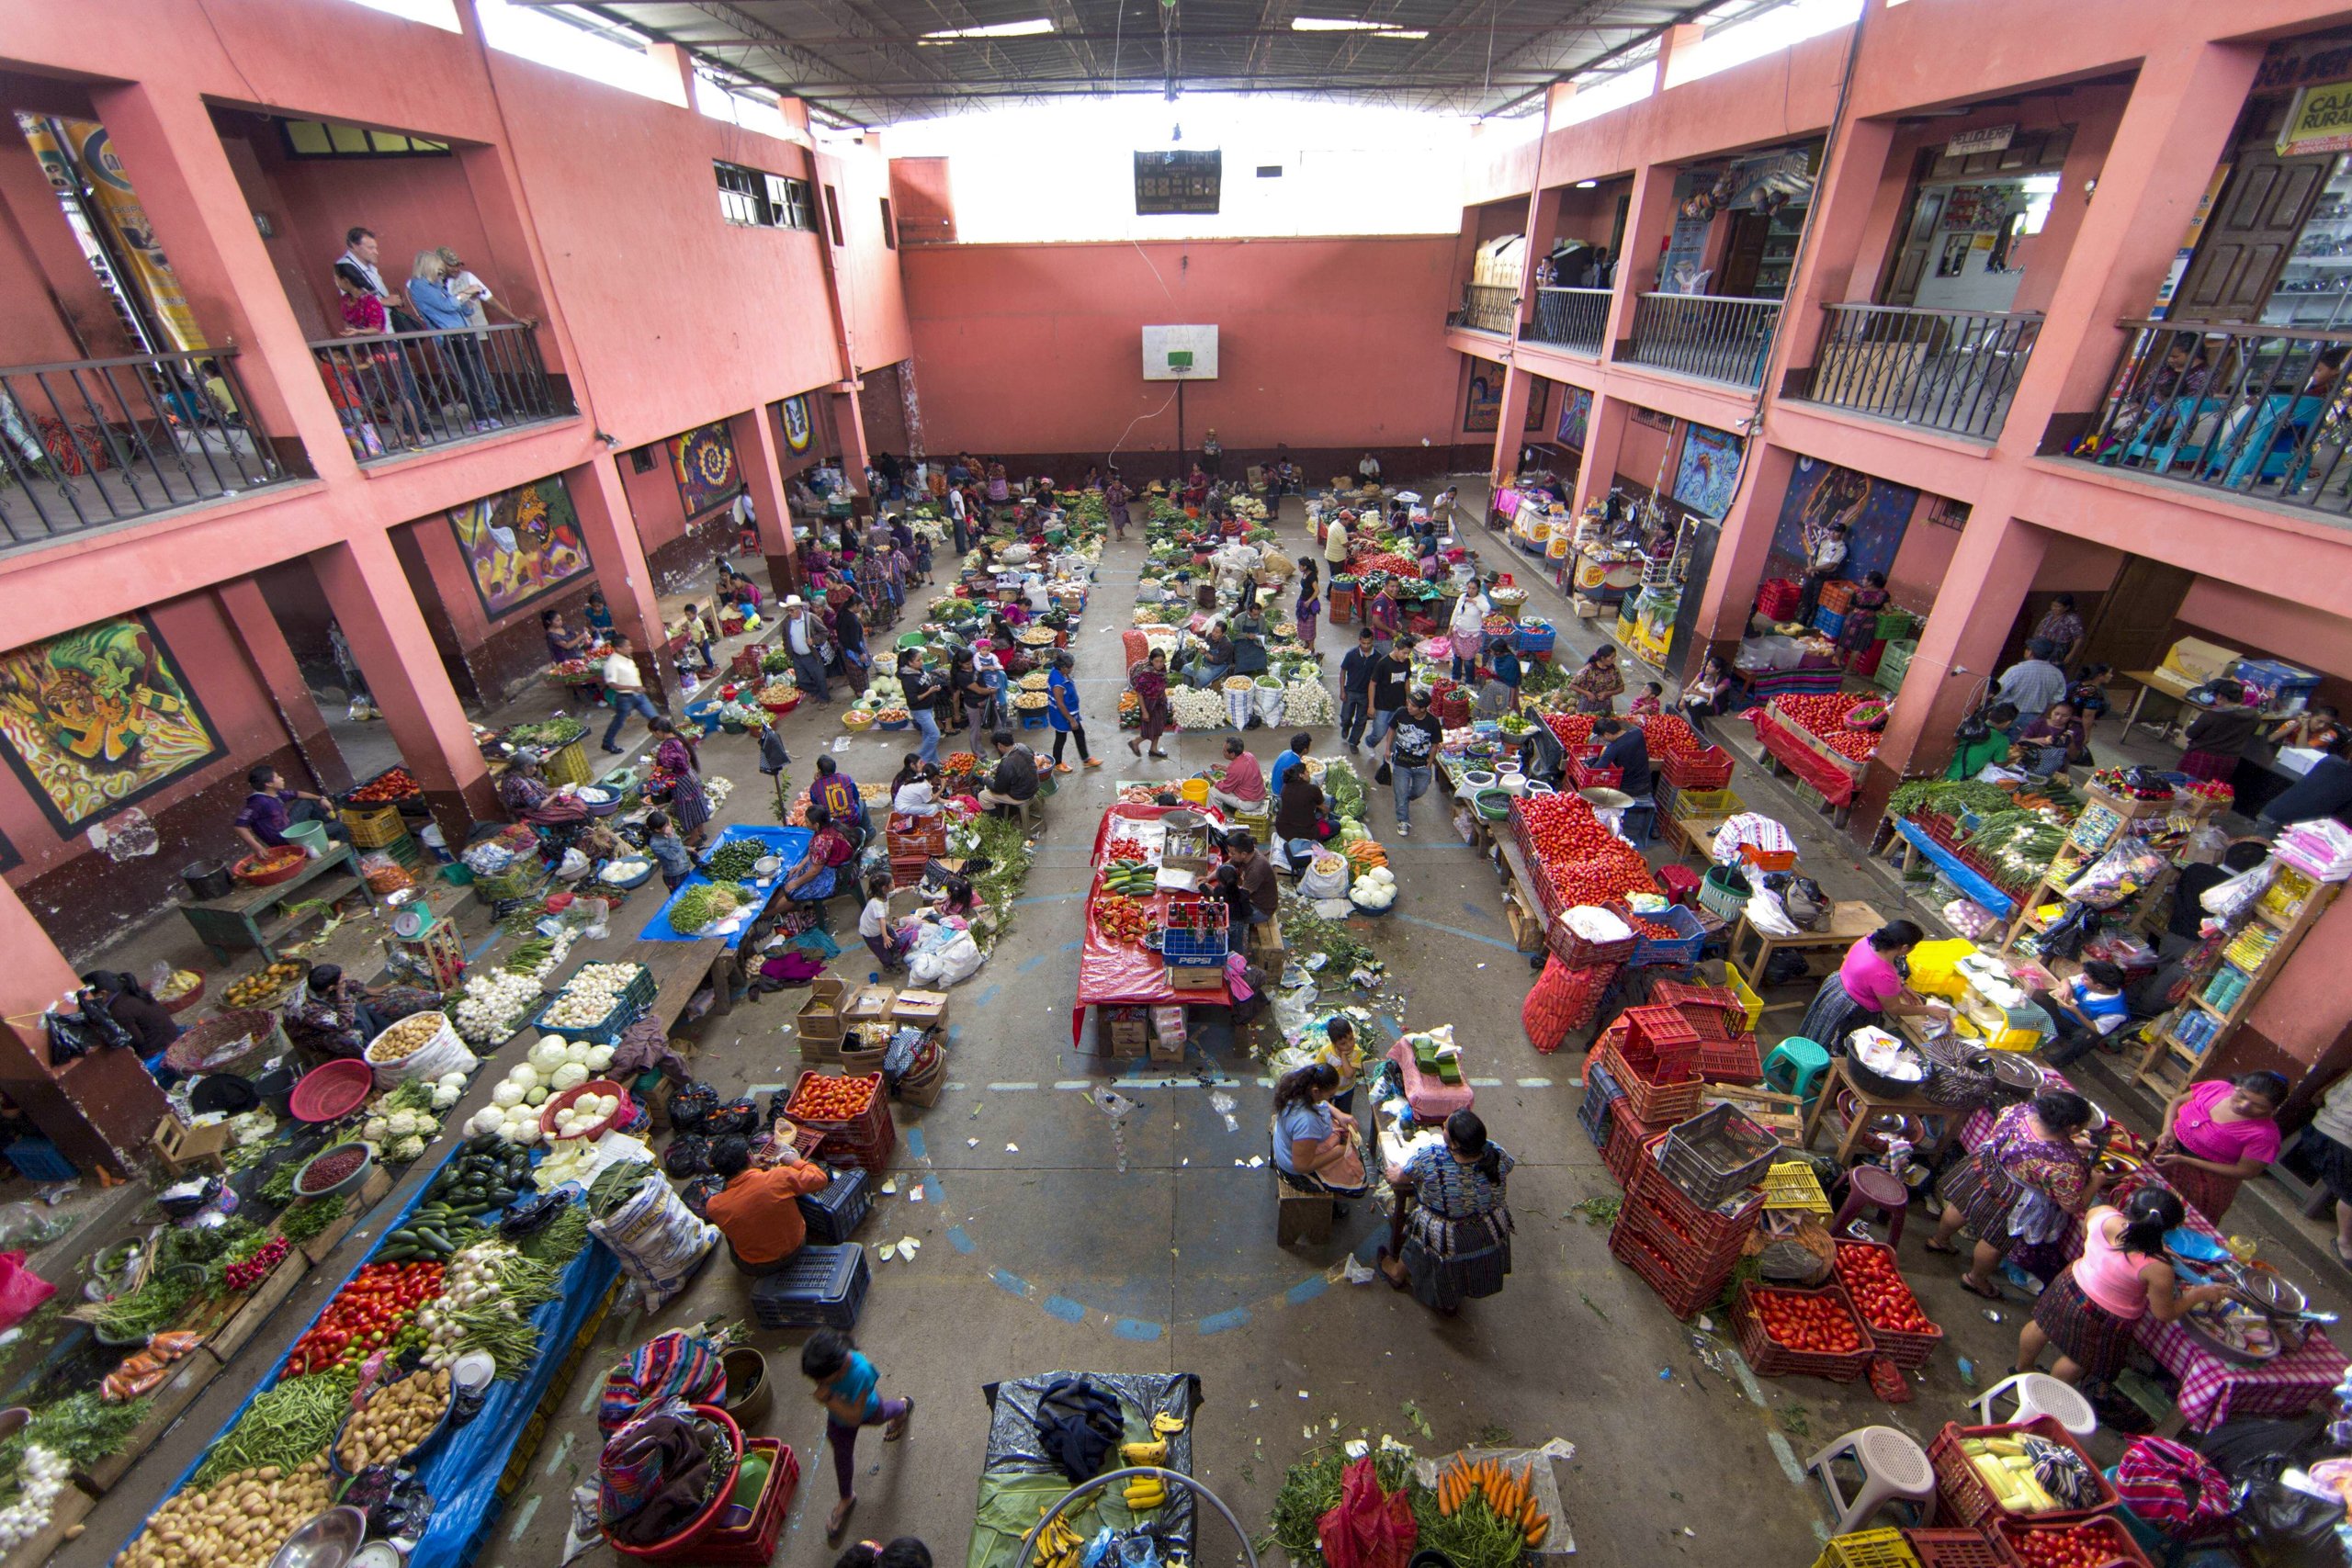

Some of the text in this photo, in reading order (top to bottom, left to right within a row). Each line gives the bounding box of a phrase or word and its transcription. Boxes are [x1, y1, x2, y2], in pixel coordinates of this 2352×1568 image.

[2308, 93, 2352, 112] CAJ
[1185, 152, 1215, 164] LOCAL
[825, 787, 848, 813] 10
